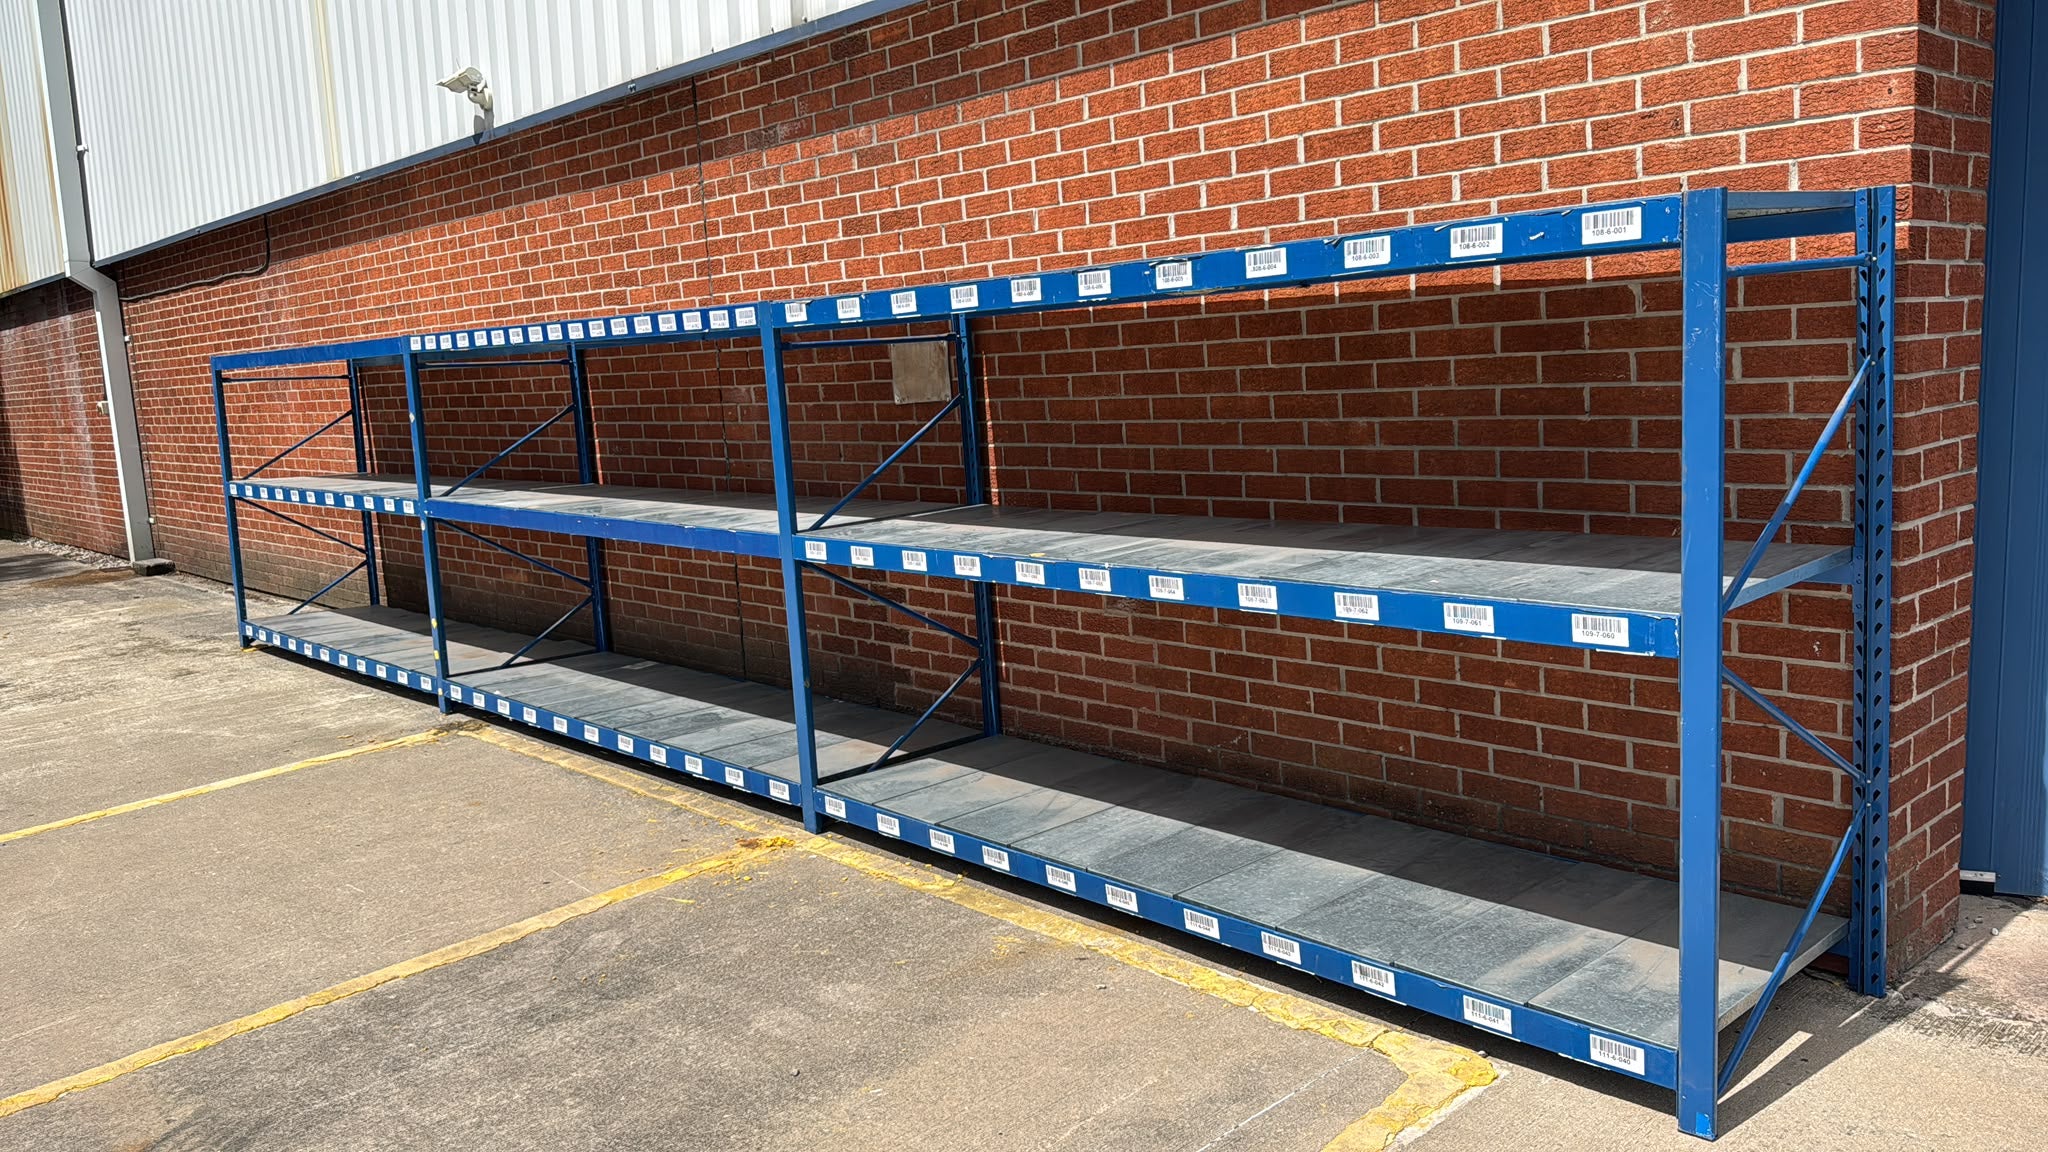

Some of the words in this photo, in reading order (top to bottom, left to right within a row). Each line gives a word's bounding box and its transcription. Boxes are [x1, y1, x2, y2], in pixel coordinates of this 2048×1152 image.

[1592, 226, 1627, 237] 108-6-001
[1459, 240, 1491, 251] 108-6-002
[1352, 252, 1380, 262] 108-6-003
[1452, 617, 1482, 627] 109-7-061
[1581, 630, 1616, 640] 109-7-060
[1471, 1010, 1500, 1025] 111-6-041
[1598, 1050, 1631, 1066] 111-6-040
